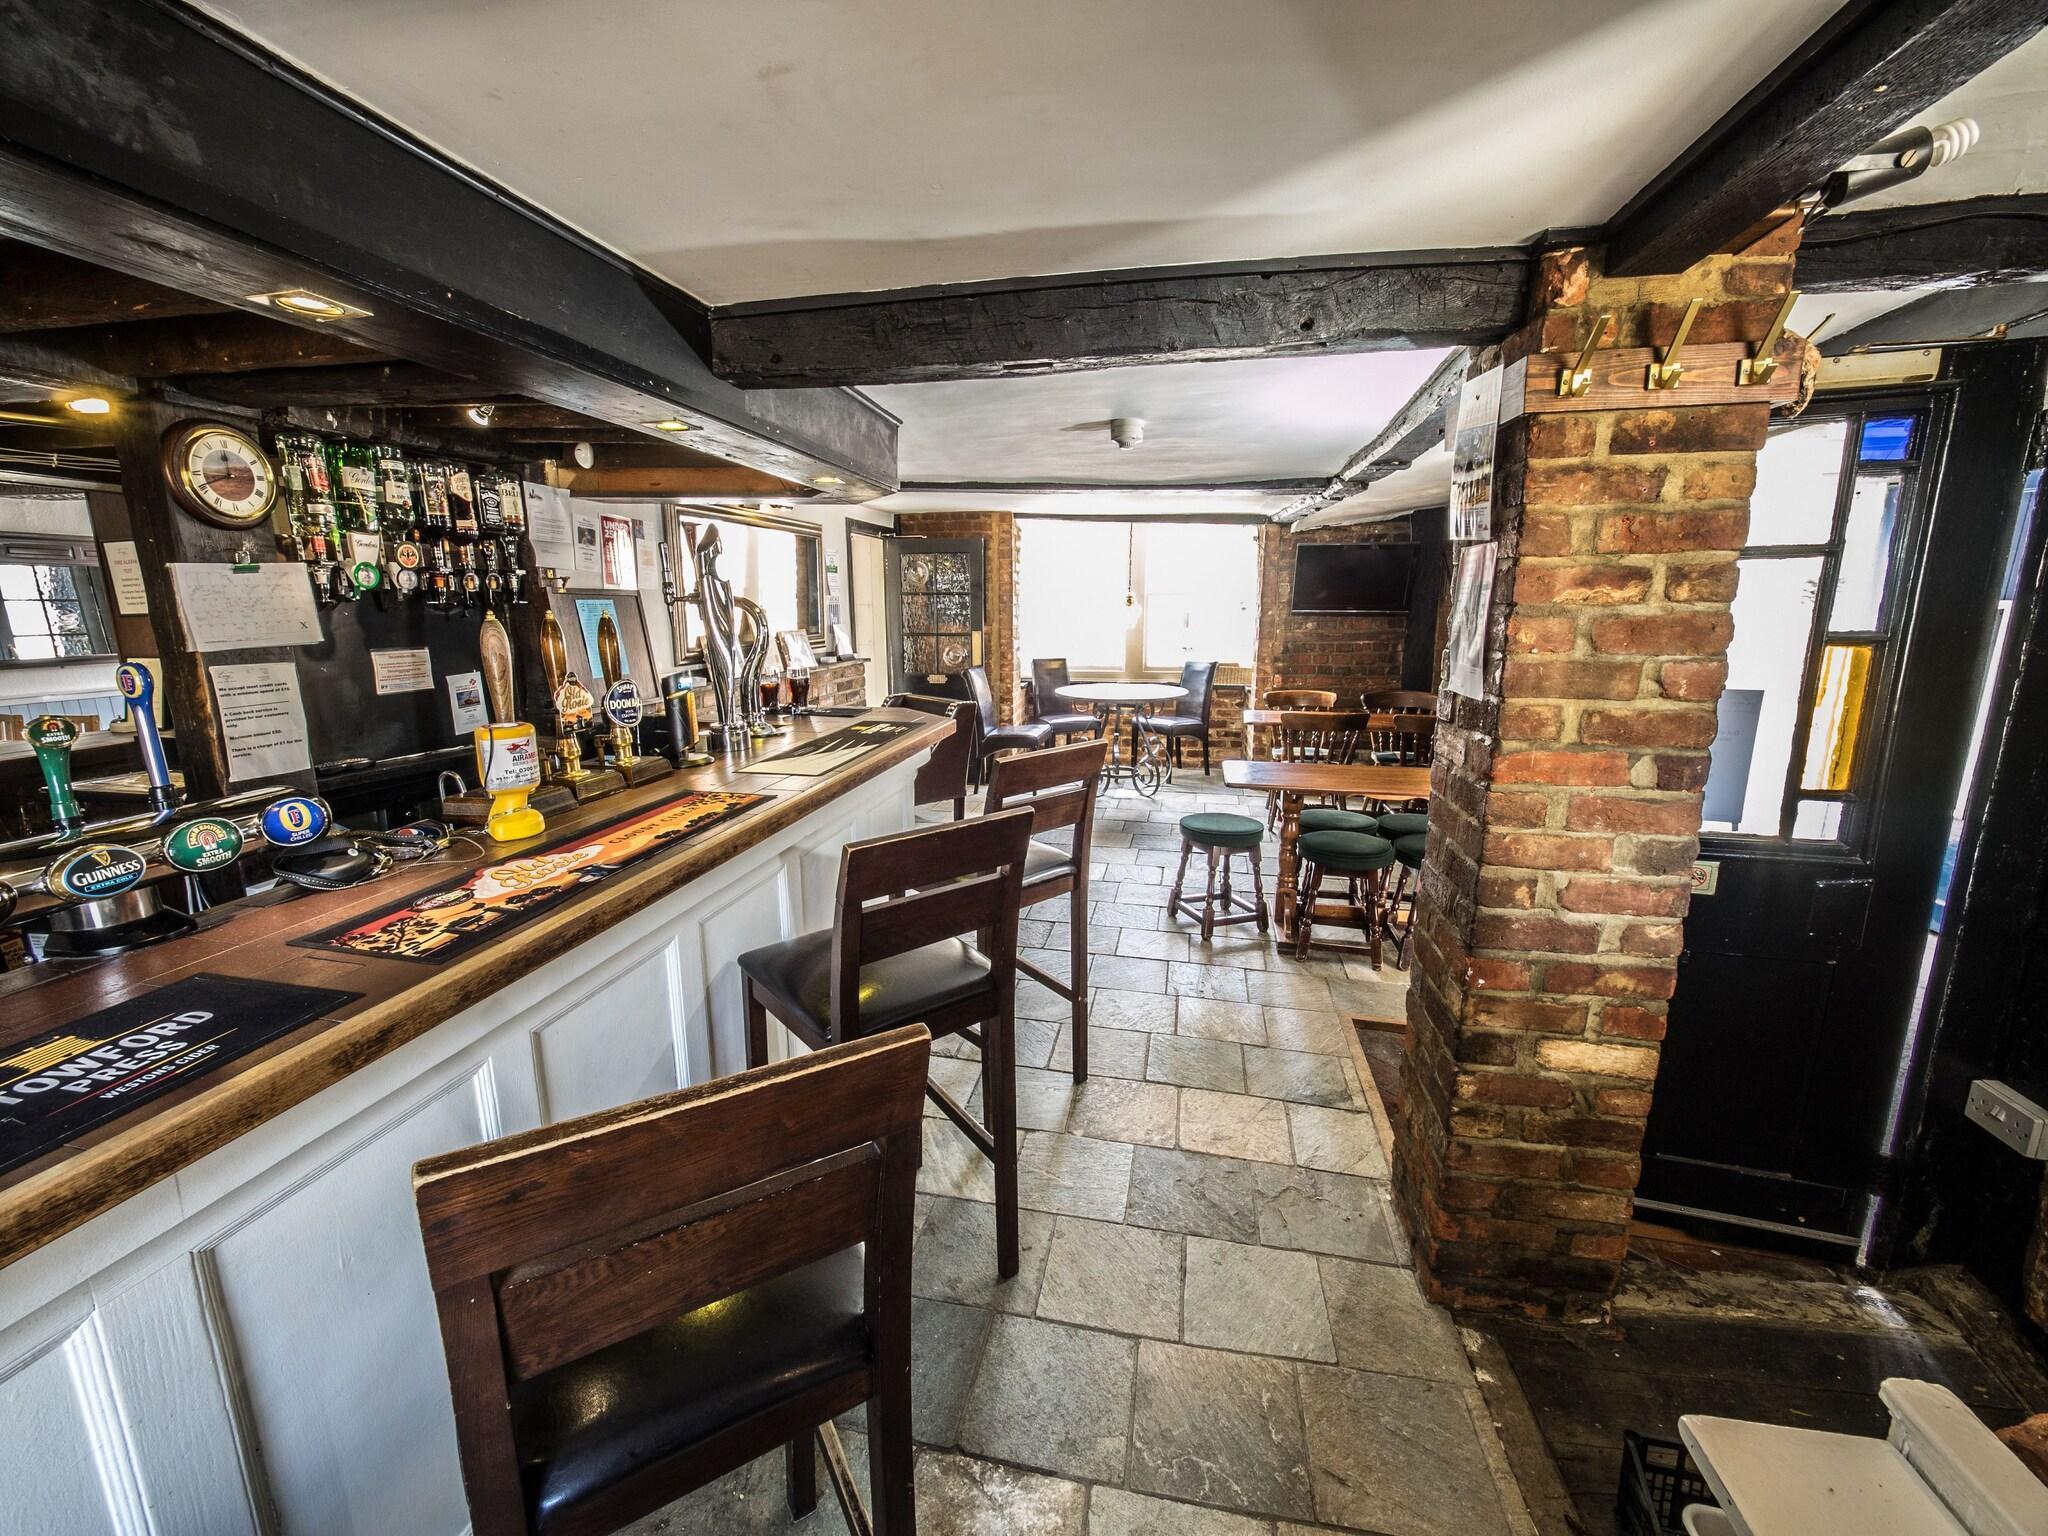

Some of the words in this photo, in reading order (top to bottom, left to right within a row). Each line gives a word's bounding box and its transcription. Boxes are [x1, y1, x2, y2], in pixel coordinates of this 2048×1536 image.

[603, 520, 630, 531] UNDER
[564, 685, 582, 700] Old
[290, 832, 314, 842] CHILLED
[291, 829, 311, 838] SUPER
[195, 850, 233, 867] SMOOTH
[202, 848, 225, 859] EXTRA
[72, 859, 141, 887] GUINNESS
[60, 1040, 188, 1093] PRESS
[100, 1064, 176, 1100] WESTONS
[176, 1043, 221, 1064] CIDER
